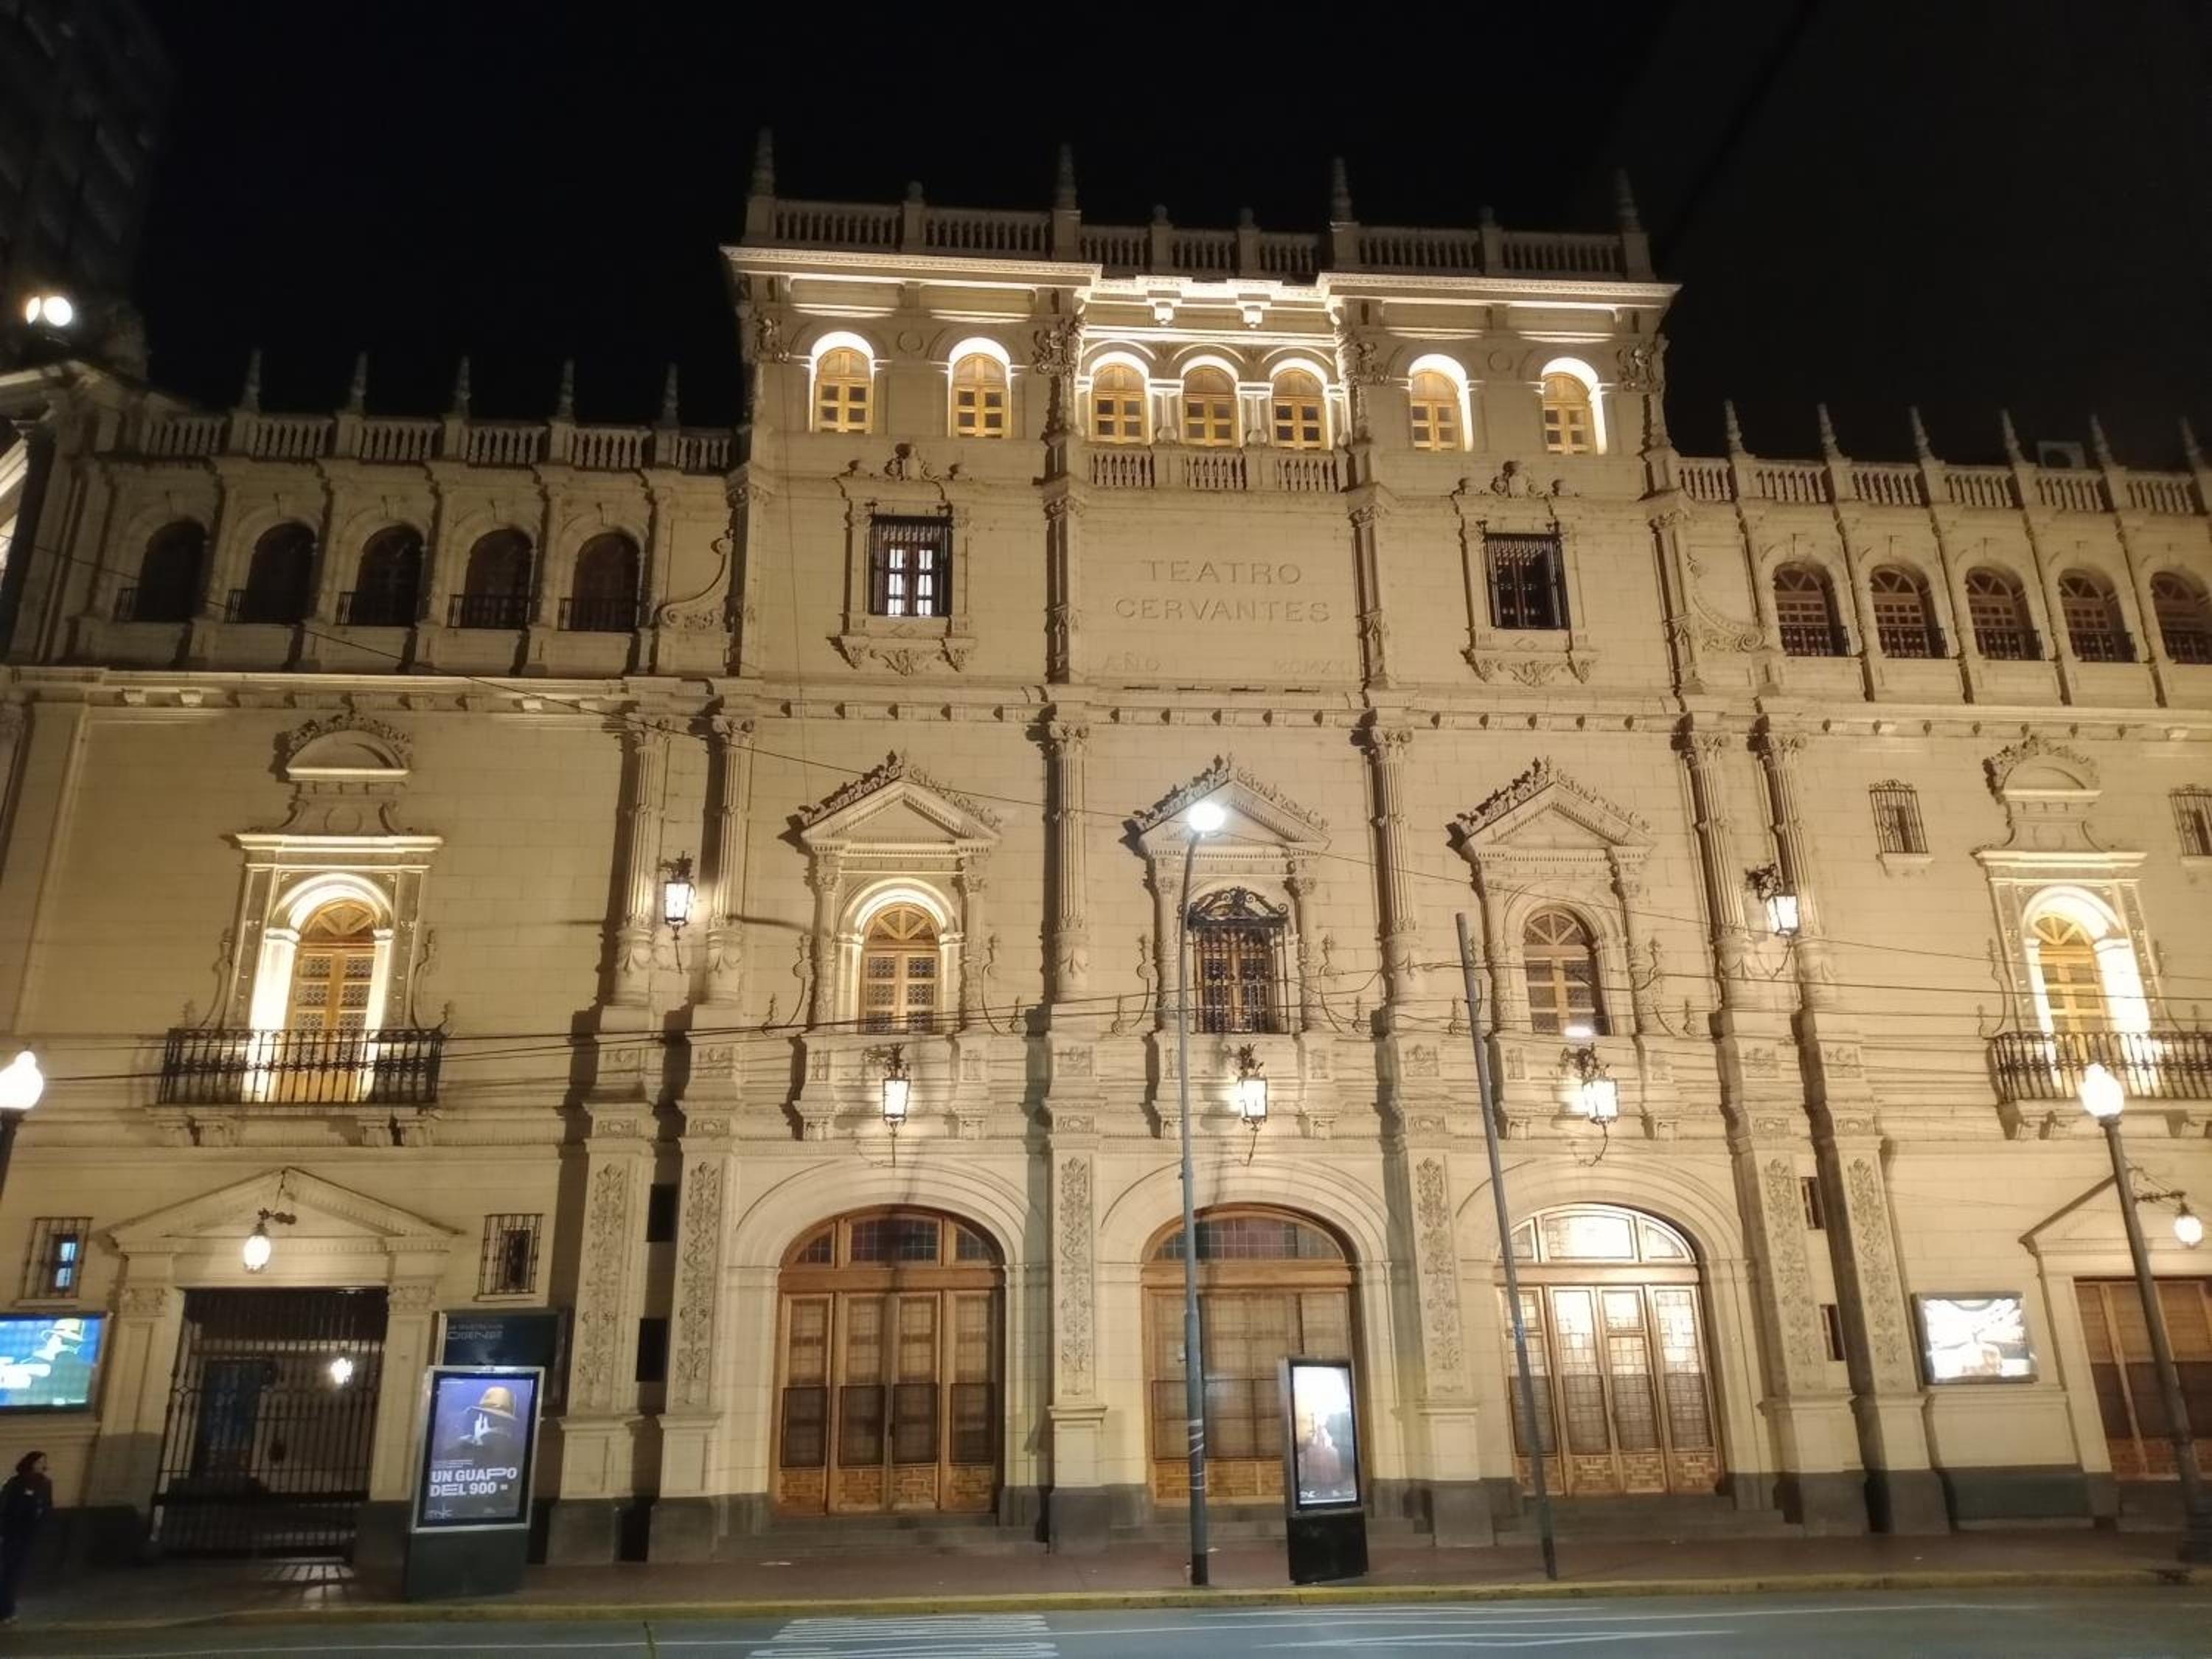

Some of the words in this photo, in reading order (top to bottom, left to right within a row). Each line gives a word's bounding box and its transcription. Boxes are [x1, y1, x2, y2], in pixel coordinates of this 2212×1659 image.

[1141, 560, 1301, 585] TEATRO
[1115, 598, 1330, 622] CERVANTES
[431, 1470, 453, 1483] UN
[455, 1467, 518, 1481] GUAPO
[429, 1484, 467, 1498] DEL
[469, 1481, 497, 1495] 900
